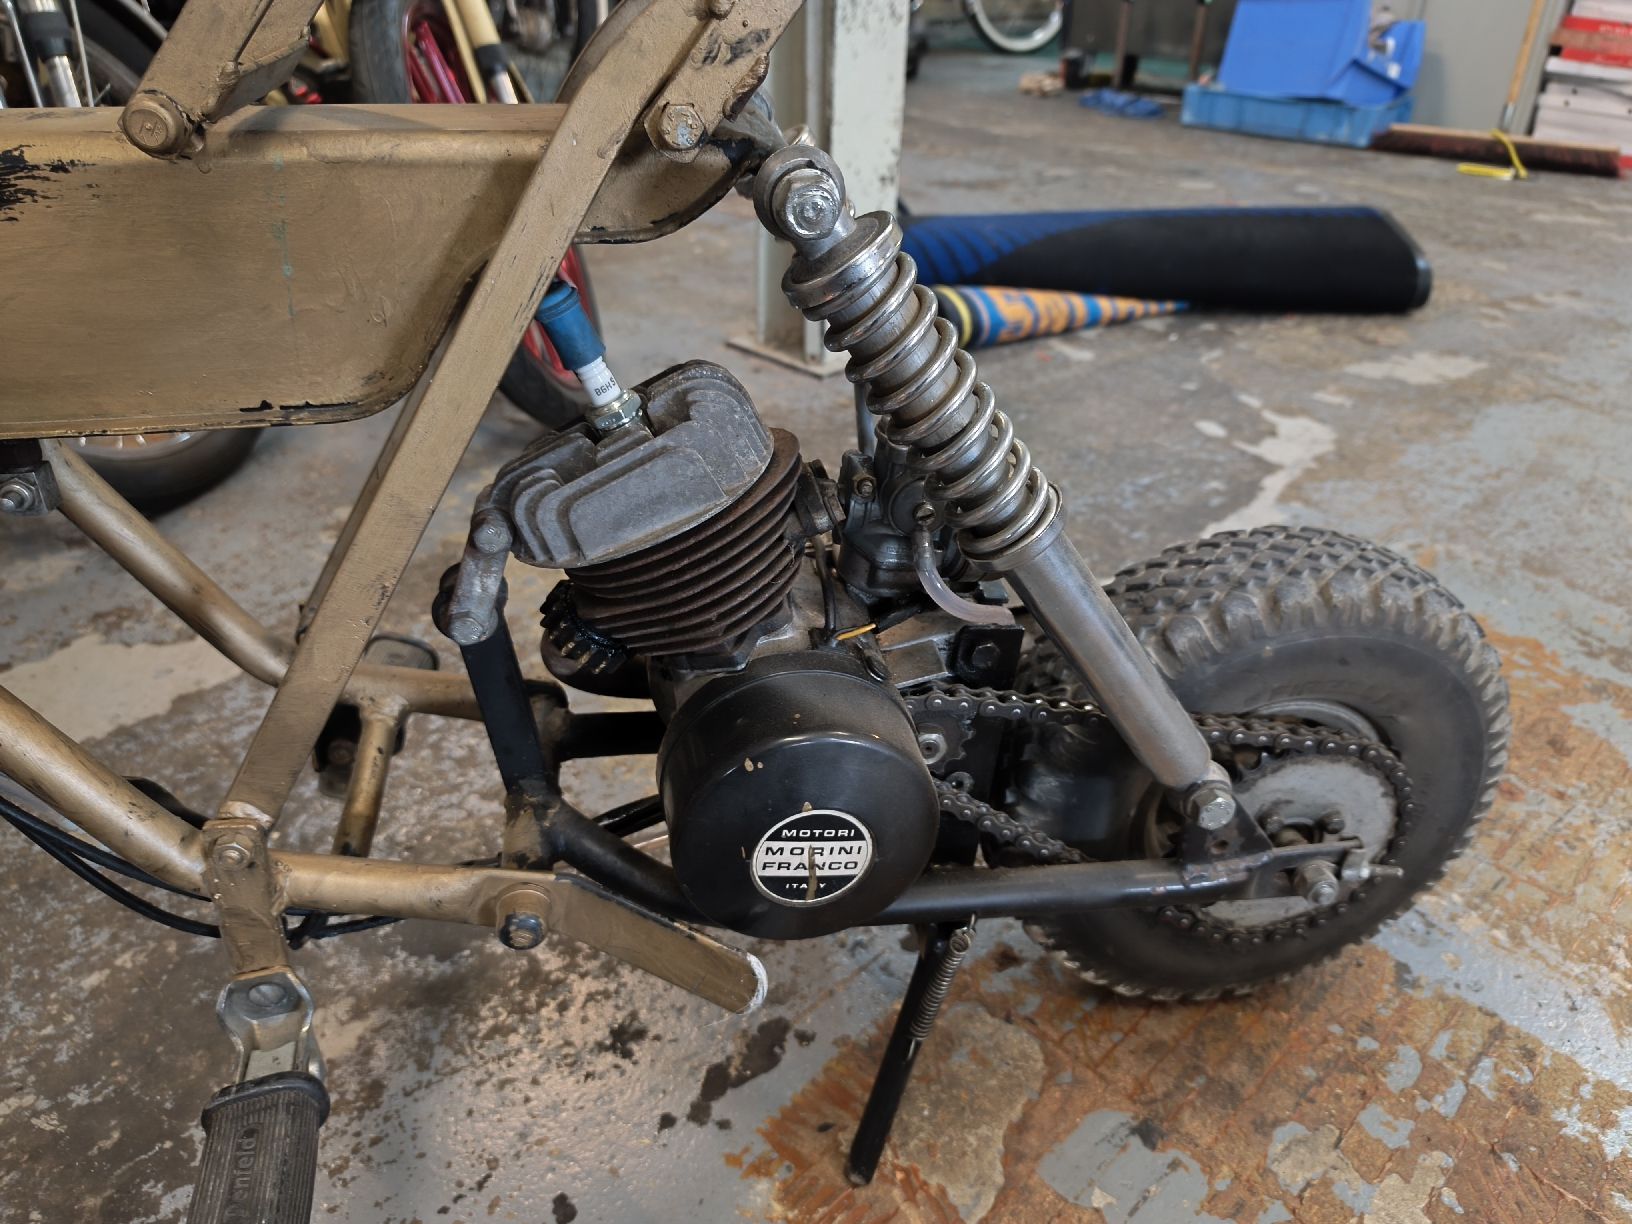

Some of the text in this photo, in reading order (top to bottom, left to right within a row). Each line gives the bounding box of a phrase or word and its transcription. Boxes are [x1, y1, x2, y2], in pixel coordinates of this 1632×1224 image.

[781, 829, 855, 837] MOTORI
[765, 845, 863, 856] MORINI
[761, 861, 859, 871] FRANCO
